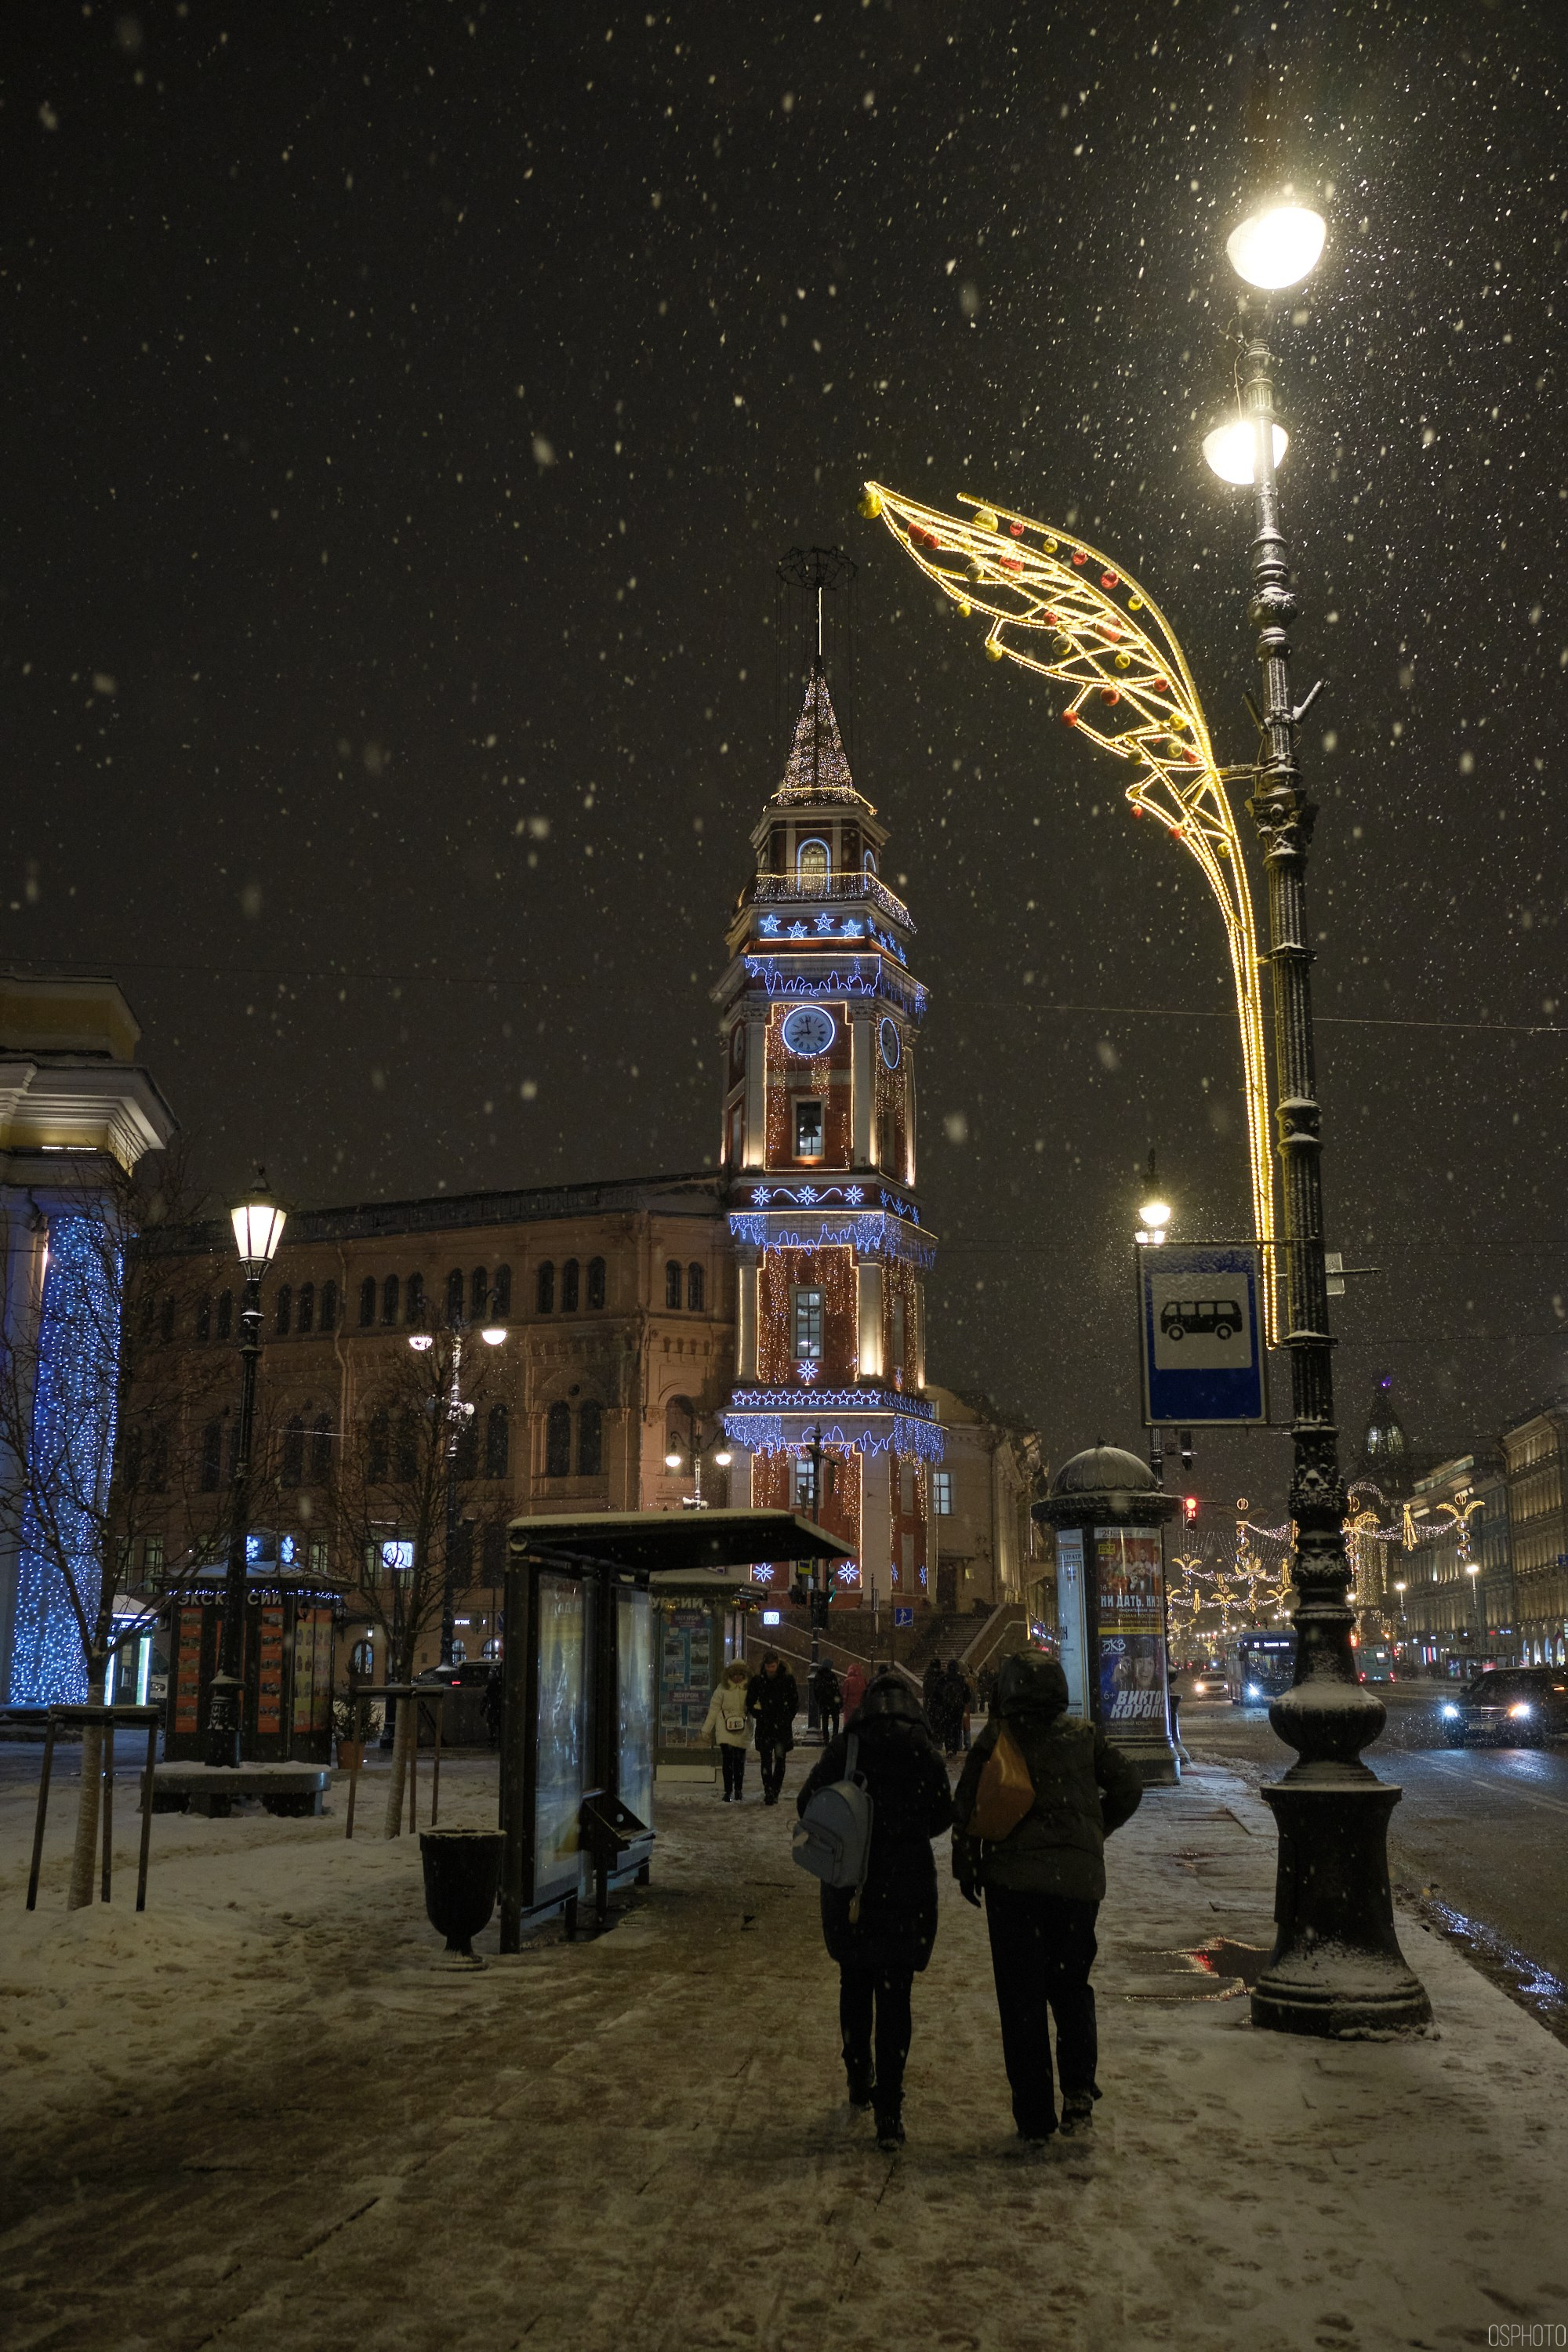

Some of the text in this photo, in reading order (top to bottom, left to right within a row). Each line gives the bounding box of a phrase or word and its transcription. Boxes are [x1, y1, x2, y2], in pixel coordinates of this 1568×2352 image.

[177, 1592, 282, 1606] ЭКСКСИИ
[1101, 1595, 1113, 1607] НИ
[1146, 1595, 1156, 1607] НИ
[1103, 1690, 1116, 1700] 6+
